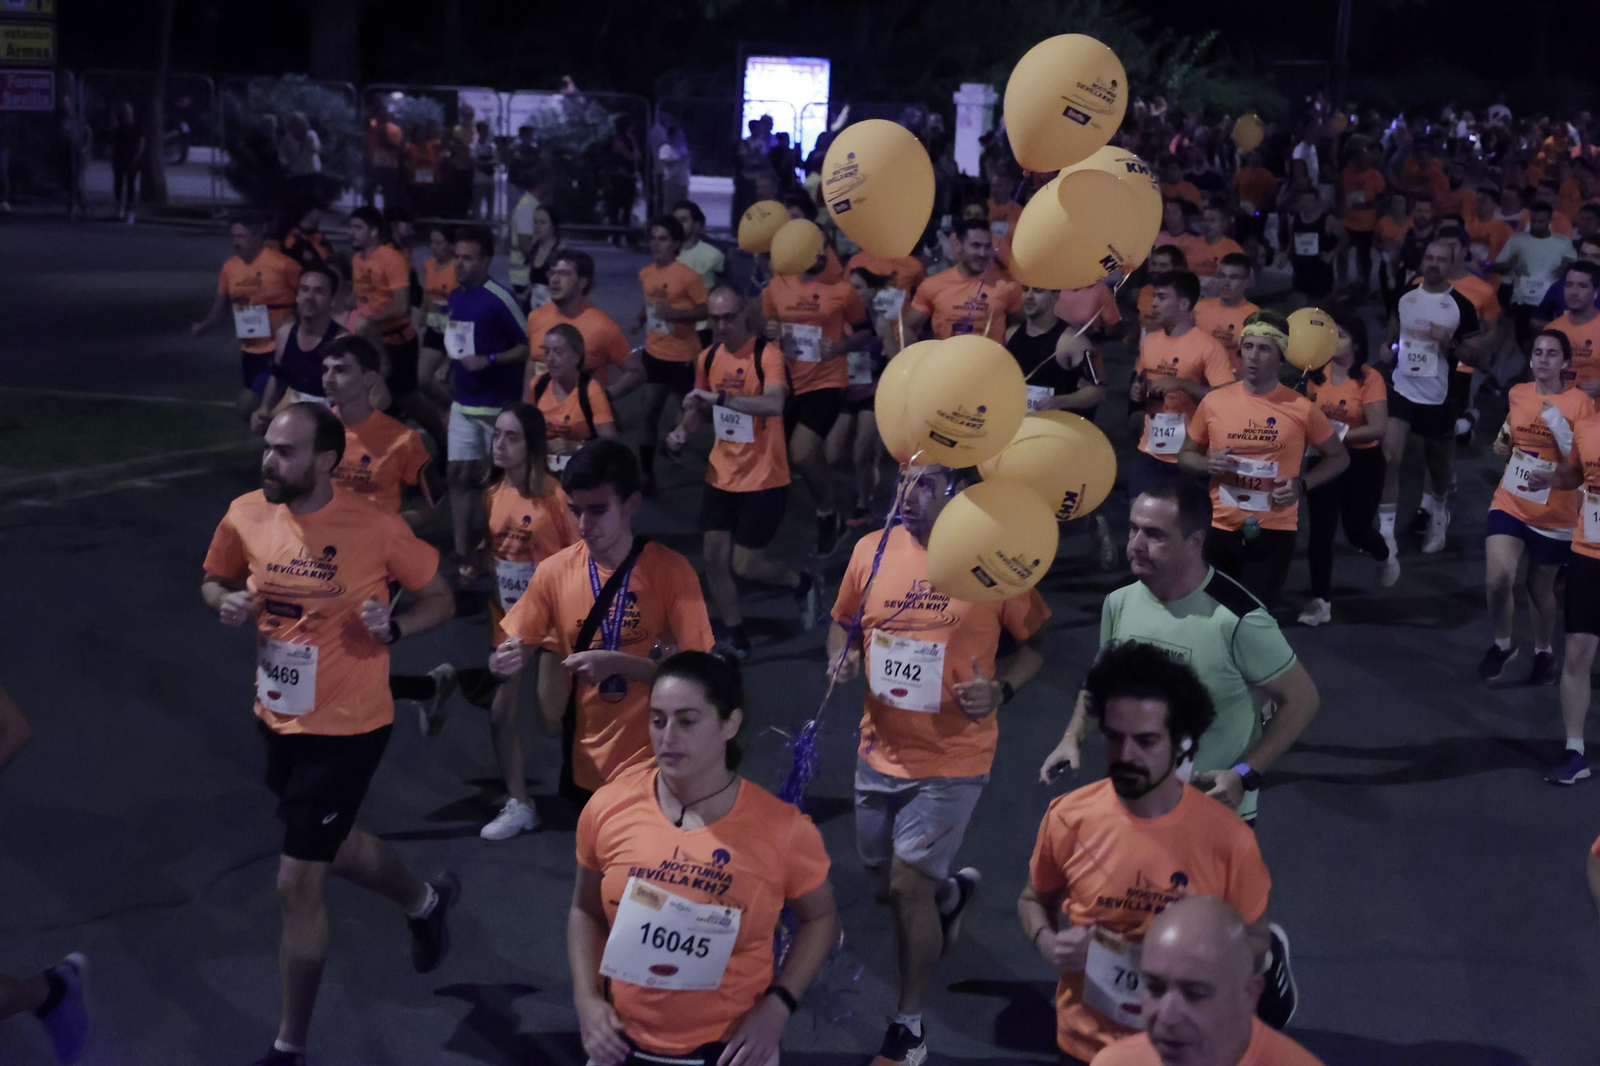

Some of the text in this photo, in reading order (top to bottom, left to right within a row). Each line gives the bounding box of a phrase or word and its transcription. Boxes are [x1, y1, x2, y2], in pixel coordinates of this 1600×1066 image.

[1227, 432, 1278, 443] SEVILLA KH7
[1243, 428, 1279, 436] NOCTURNA
[1515, 466, 1530, 480] 116
[266, 563, 335, 581] SEVILLA KH7
[884, 659, 922, 681] 8742
[628, 867, 730, 896] SEVILLA KH7
[659, 860, 733, 884] NOCTURNA
[640, 922, 711, 958] 16045
